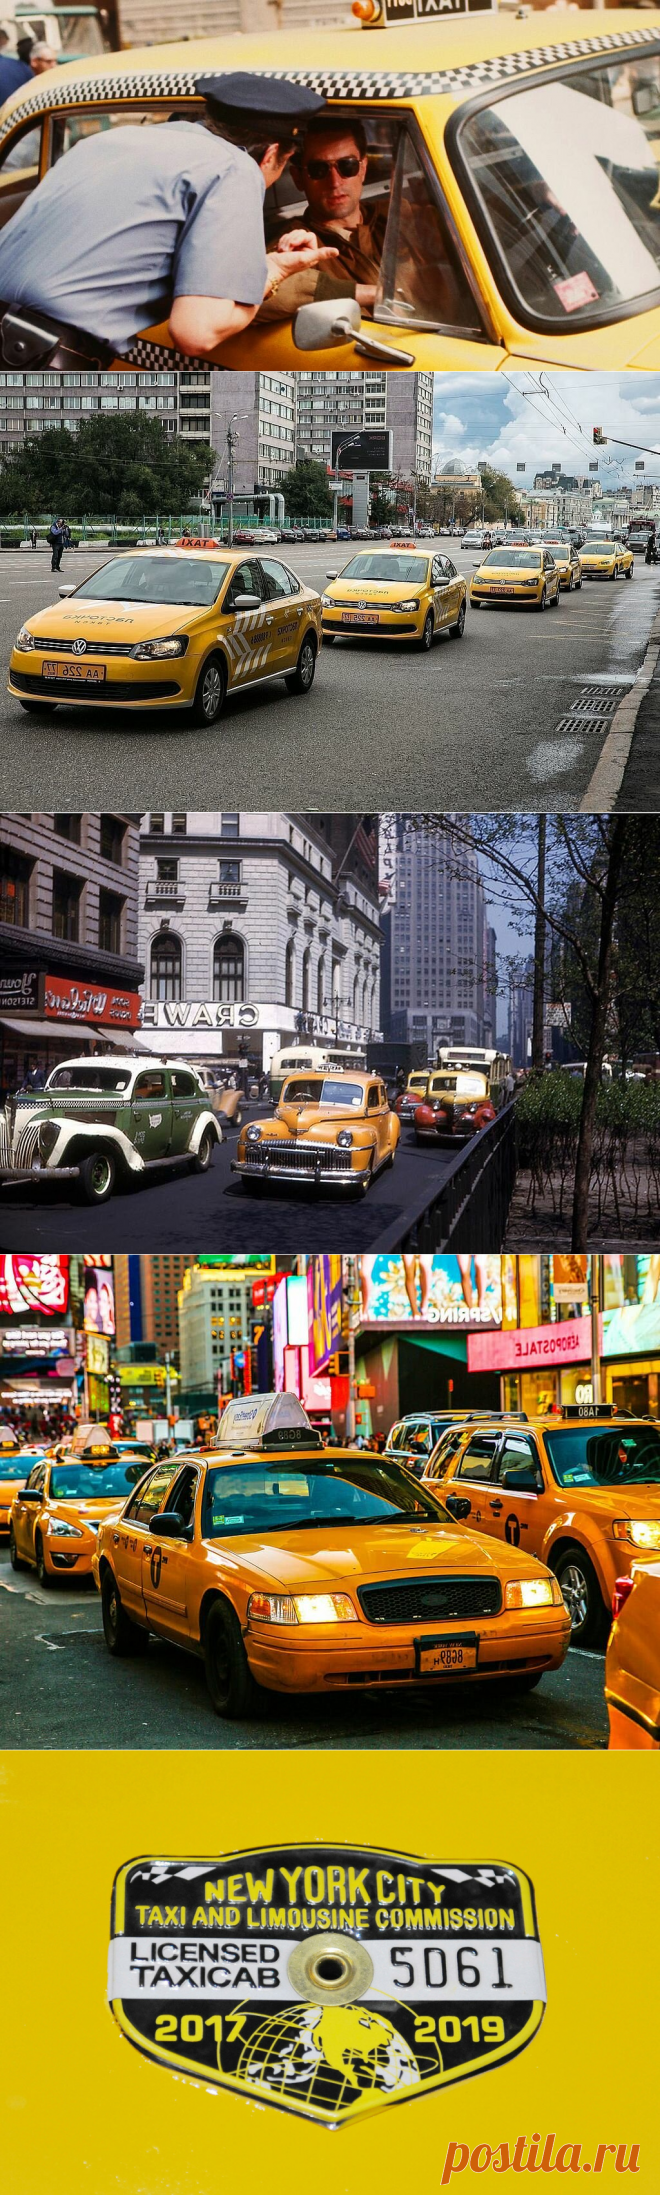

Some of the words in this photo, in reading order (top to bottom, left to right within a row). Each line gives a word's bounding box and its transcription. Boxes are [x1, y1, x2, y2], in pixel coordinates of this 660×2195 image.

[205, 1869, 273, 1904] NEW
[280, 1866, 369, 1904] YORK
[376, 1870, 446, 1905] CITY
[136, 1906, 186, 1927] TAXI
[192, 1907, 241, 1928] AND
[247, 1907, 369, 1929] LIMOUSINE
[375, 1908, 516, 1930] COMMISSION
[130, 1942, 280, 1964] LICENSED
[130, 1966, 281, 1989] TAXICAB
[155, 2015, 246, 2042] 2017
[414, 2015, 506, 2043] 2019
